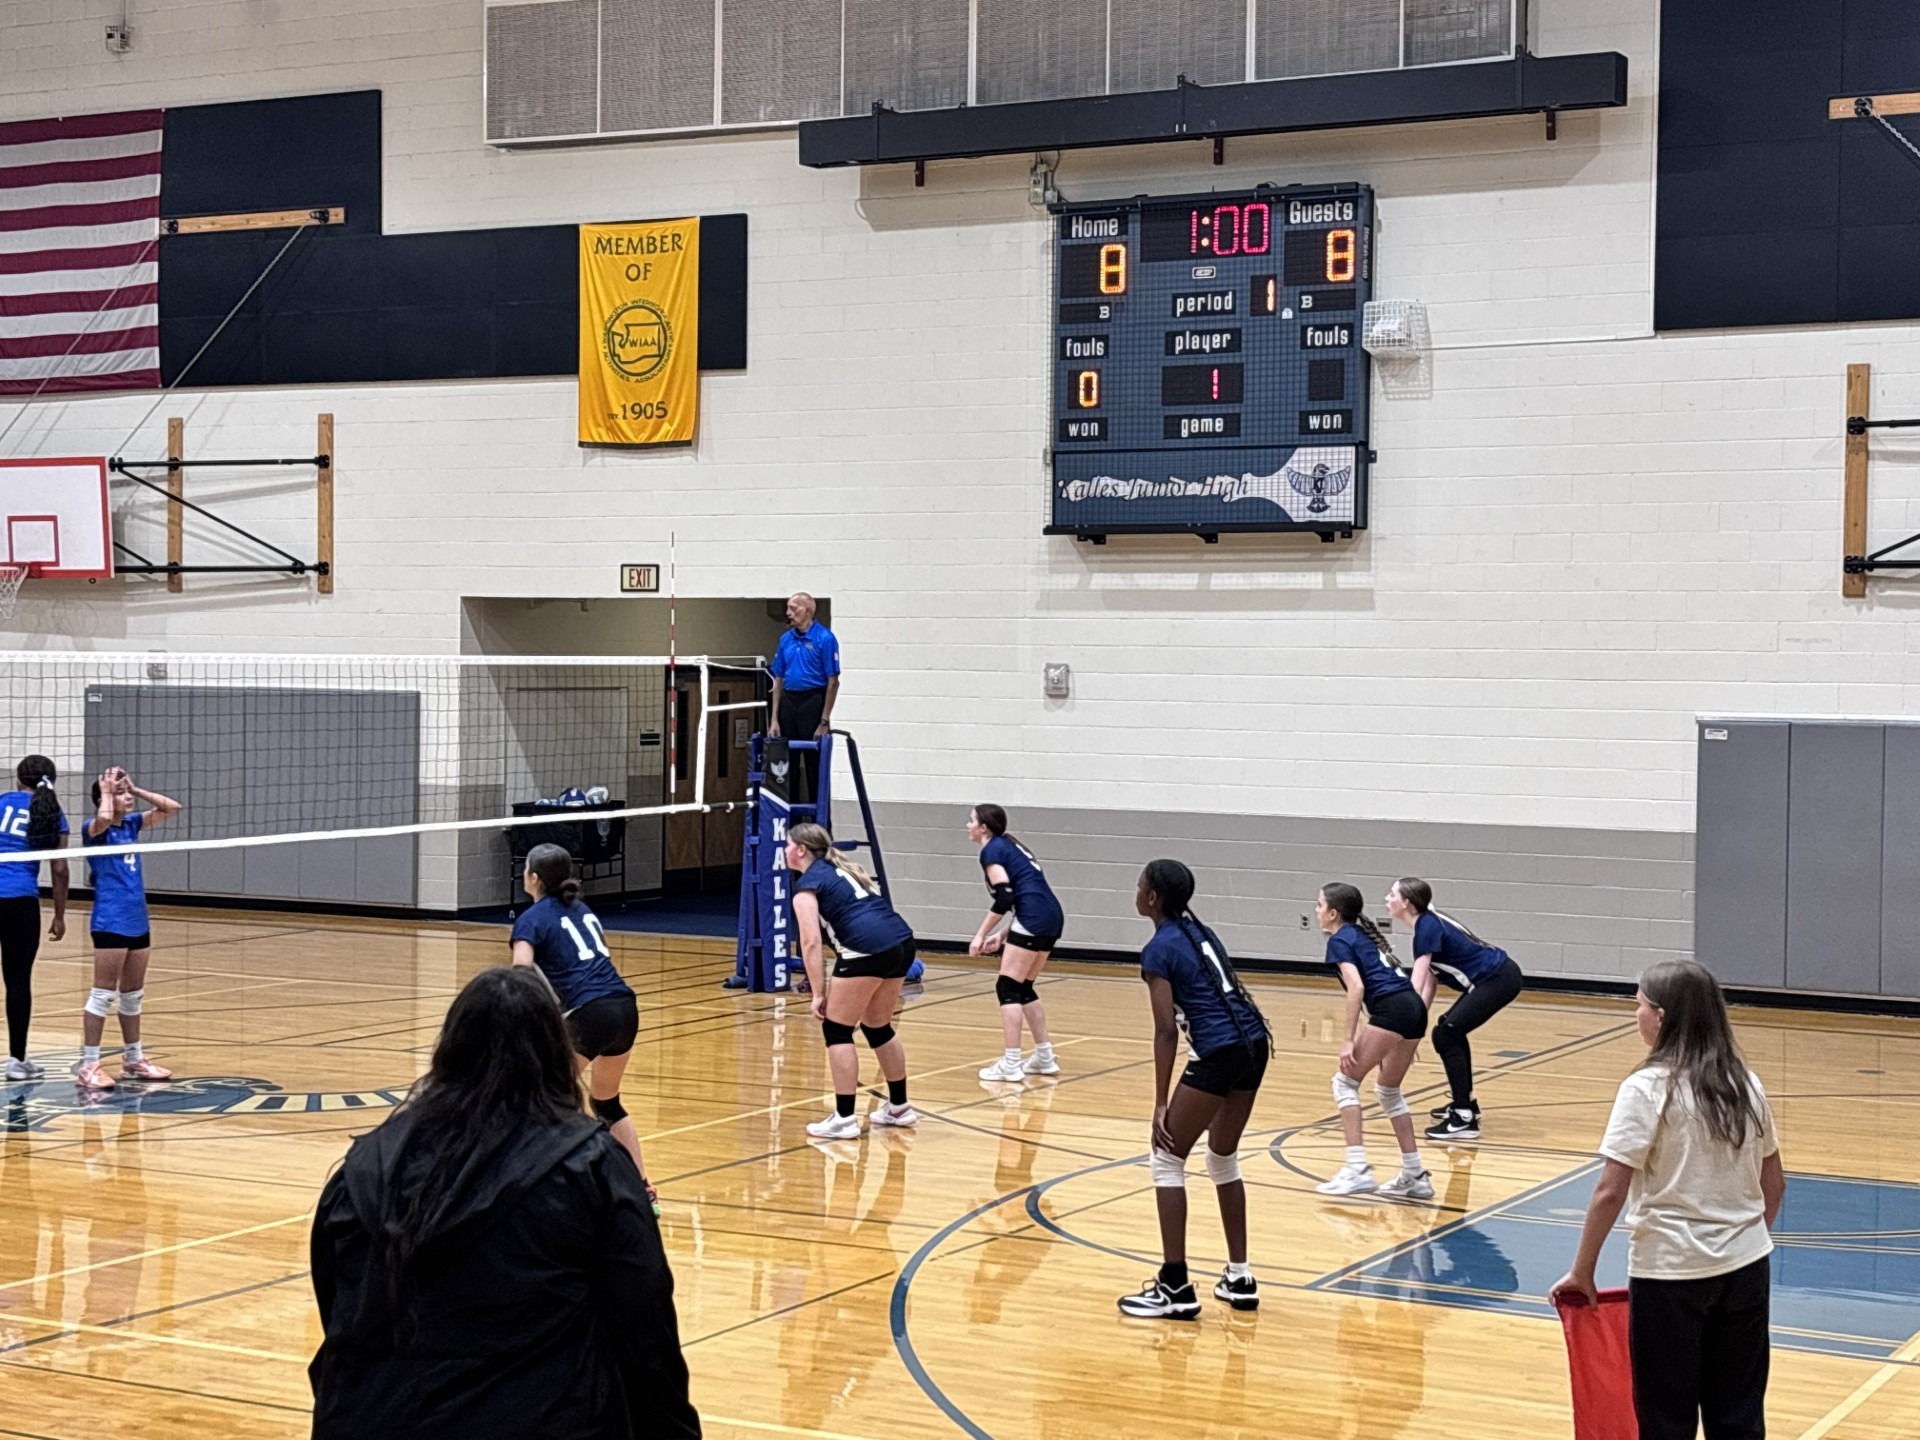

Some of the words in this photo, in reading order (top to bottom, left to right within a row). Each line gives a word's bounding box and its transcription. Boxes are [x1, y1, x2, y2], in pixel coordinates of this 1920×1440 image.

[1289, 202, 1353, 224] Guests
[1072, 217, 1118, 238] Home
[1191, 203, 1269, 255] 1:00
[594, 233, 683, 255] MEMBER
[1327, 229, 1355, 282] 8
[625, 263, 652, 281] OF
[1100, 244, 1126, 294] 8
[1176, 292, 1233, 317] period
[1266, 278, 1275, 312] 1
[1301, 296, 1312, 308] B
[1099, 307, 1110, 319] B
[629, 337, 657, 348] WIAA
[1175, 332, 1231, 355] player
[1306, 327, 1349, 346] fouls
[1066, 339, 1105, 358] fouls
[1078, 371, 1098, 407] 0
[1213, 368, 1219, 400] 1
[621, 401, 668, 420] 1905
[1309, 413, 1342, 429] won
[1068, 420, 1099, 437] won
[1181, 417, 1224, 437] game
[1058, 477, 1119, 500] Kalles
[1124, 477, 1190, 500] Junior
[1199, 474, 1250, 502] High
[629, 568, 651, 588] EXIT
[0, 805, 30, 837] 12
[124, 851, 136, 872] 4
[772, 818, 787, 988] KALLES
[560, 914, 610, 960] 10
